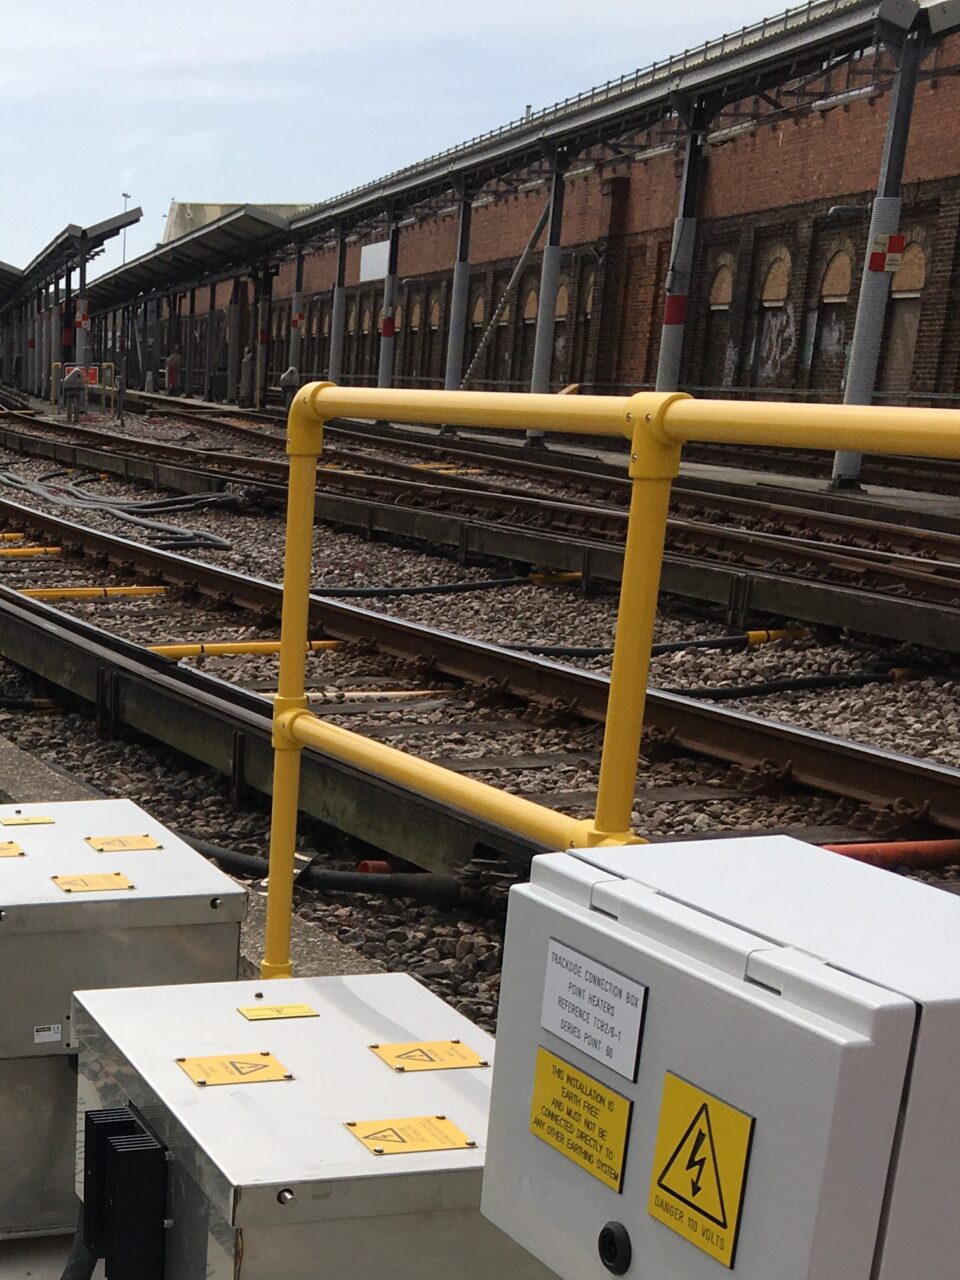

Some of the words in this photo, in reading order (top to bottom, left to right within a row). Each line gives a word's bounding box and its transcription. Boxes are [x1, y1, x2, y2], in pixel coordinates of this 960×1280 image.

[551, 951, 583, 978] TRACKSIDE
[584, 970, 623, 1000] CONNECTION
[625, 991, 640, 1009] BOX
[568, 981, 586, 1000] POINT
[588, 992, 616, 1017] HEATERS
[557, 995, 591, 1025] REFERENCE
[560, 1018, 581, 1040] SERVES
[551, 1064, 564, 1081] THIS
[566, 1074, 606, 1107] INSTALLATION
[607, 1100, 615, 1113] IS
[561, 1086, 581, 1107] EARTH
[582, 1100, 601, 1120] FREE
[541, 1105, 574, 1135] CONNECTED
[576, 1128, 604, 1155] DIRECTLY
[605, 1147, 614, 1161] TO
[551, 1097, 565, 1112] AND
[566, 1106, 582, 1124] MUST
[583, 1117, 597, 1133] NOT
[597, 1127, 608, 1142] BE
[533, 1116, 546, 1130] ANY
[546, 1124, 565, 1145] OTHER
[566, 1138, 594, 1165] EARTHING
[595, 1158, 620, 1182] SYSTEM
[654, 1194, 684, 1224] DANGER
[687, 1216, 698, 1233] 110
[701, 1224, 726, 1251] VOLTS
